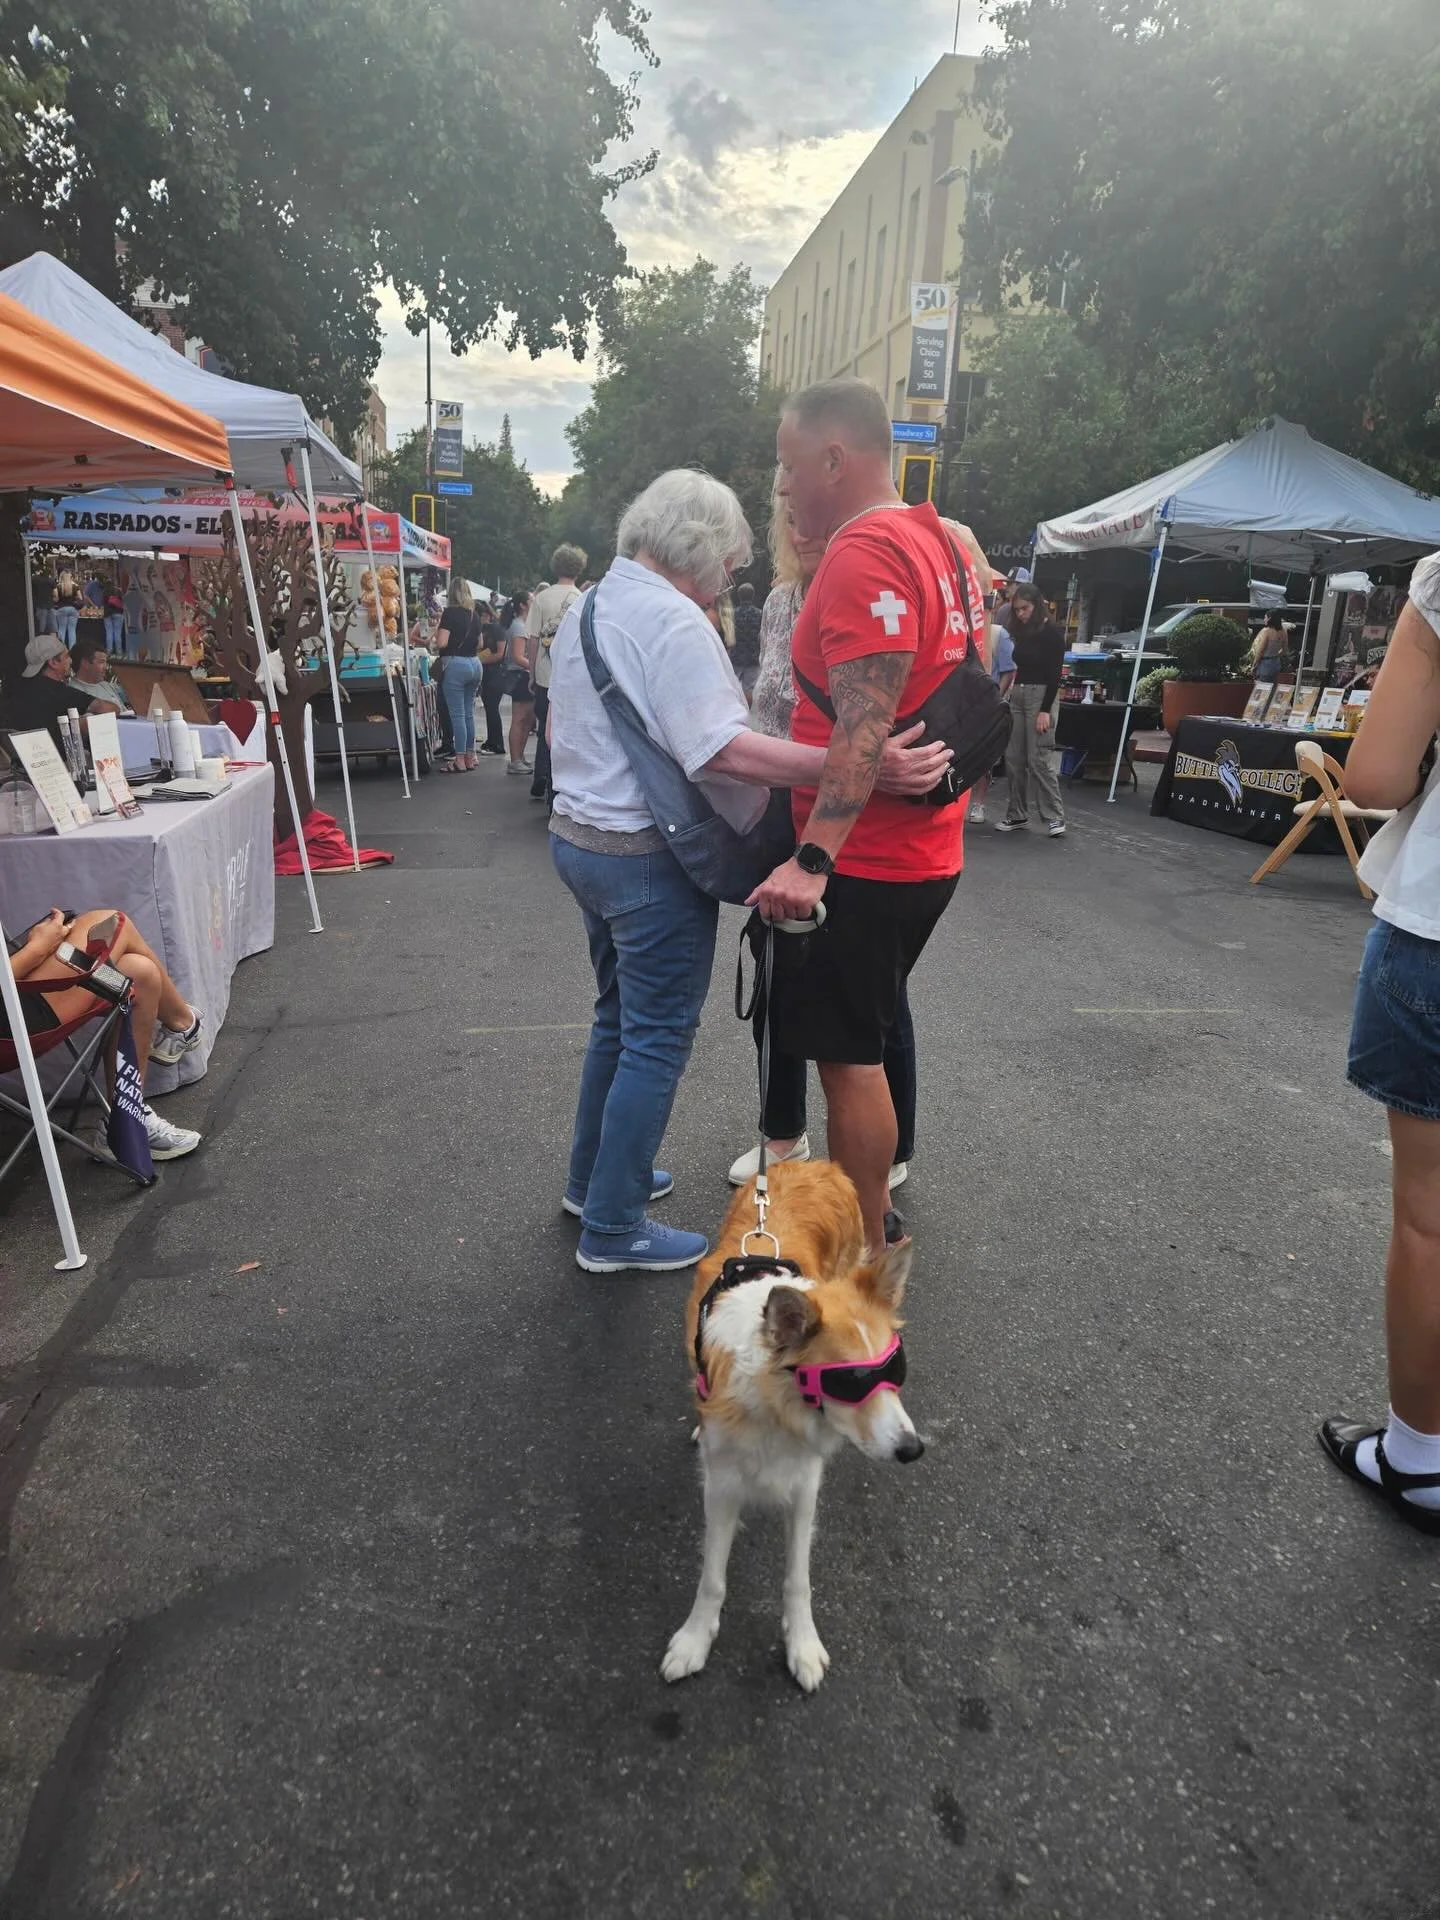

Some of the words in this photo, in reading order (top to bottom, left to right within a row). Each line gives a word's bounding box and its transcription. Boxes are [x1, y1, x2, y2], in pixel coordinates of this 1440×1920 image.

[915, 288, 946, 310] 50
[916, 336, 944, 348] Serving
[920, 347, 940, 357] Chico
[923, 359, 935, 368] for
[923, 370, 934, 378] 50
[916, 381, 937, 391] years
[439, 403, 460, 417] 50
[63, 511, 181, 534] RASPADOS
[195, 517, 222, 535] EL
[944, 648, 965, 661] ONE
[1175, 755, 1218, 777] BUTTE
[1239, 770, 1300, 795] COLLEG
